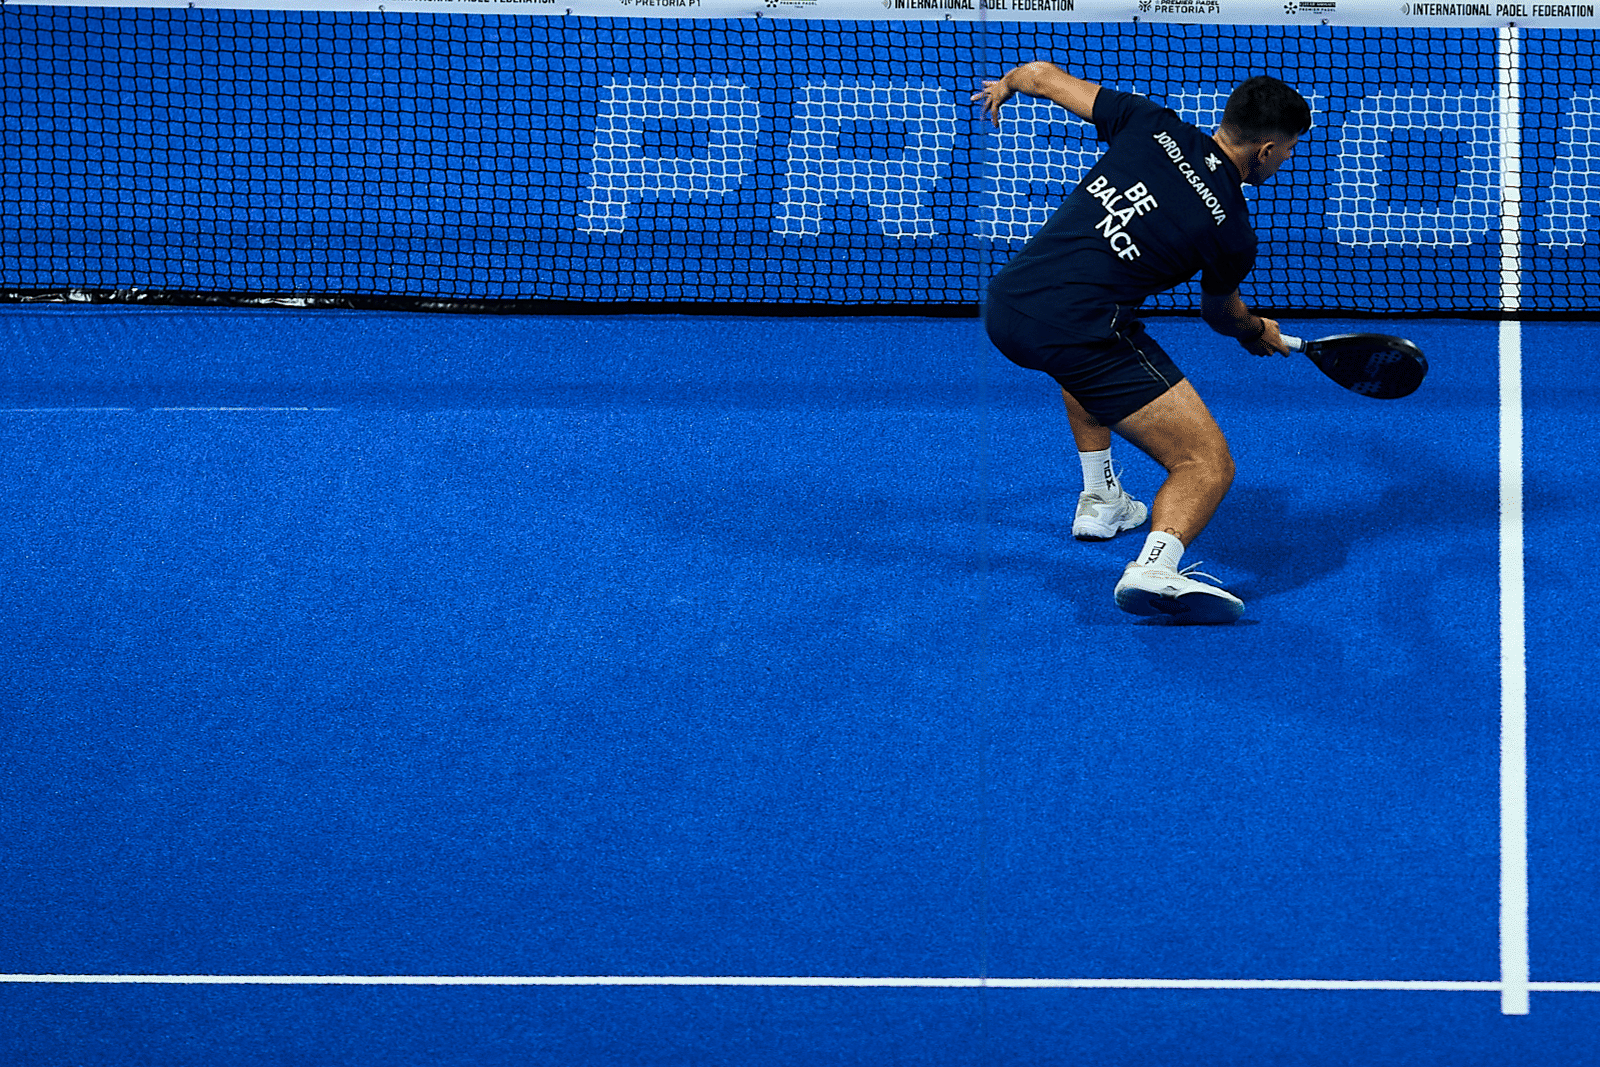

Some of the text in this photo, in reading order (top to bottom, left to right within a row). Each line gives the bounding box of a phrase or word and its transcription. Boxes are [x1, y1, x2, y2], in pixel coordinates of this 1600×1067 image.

[1013, 0, 1073, 11] FEDERATION
[1155, 6, 1220, 14] PRETORIA P1
[1414, 4, 1593, 17] INTERNATIONAL PADEL FEDERATION
[1153, 131, 1226, 225] JORDI CASANOVA
[1086, 175, 1136, 227] BALA
[1123, 181, 1158, 216] BE
[1095, 214, 1141, 261] NCE
